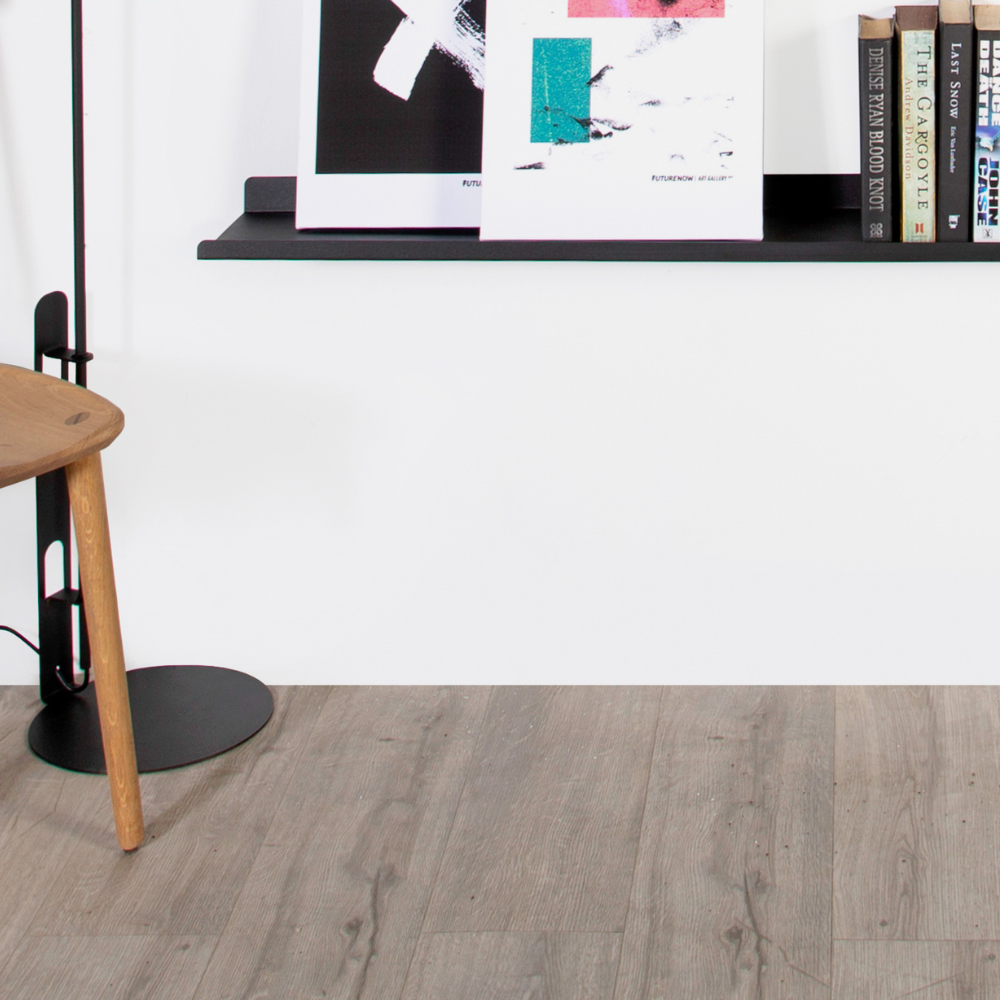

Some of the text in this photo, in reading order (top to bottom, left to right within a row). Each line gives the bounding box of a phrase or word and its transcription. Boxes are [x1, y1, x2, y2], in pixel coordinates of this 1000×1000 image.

[949, 42, 962, 119] LAST SNOW
[978, 39, 990, 126] DEATH
[868, 47, 884, 212] DENISE RYAN BLOOD KNOT
[904, 77, 914, 180] Andrew Davidson
[914, 45, 933, 210] THE GARGOYLE
[462, 179, 482, 187] FUTU
[651, 174, 694, 182] FUTURENOW
[977, 157, 989, 226] CASE
[989, 158, 1000, 226] JOHN
